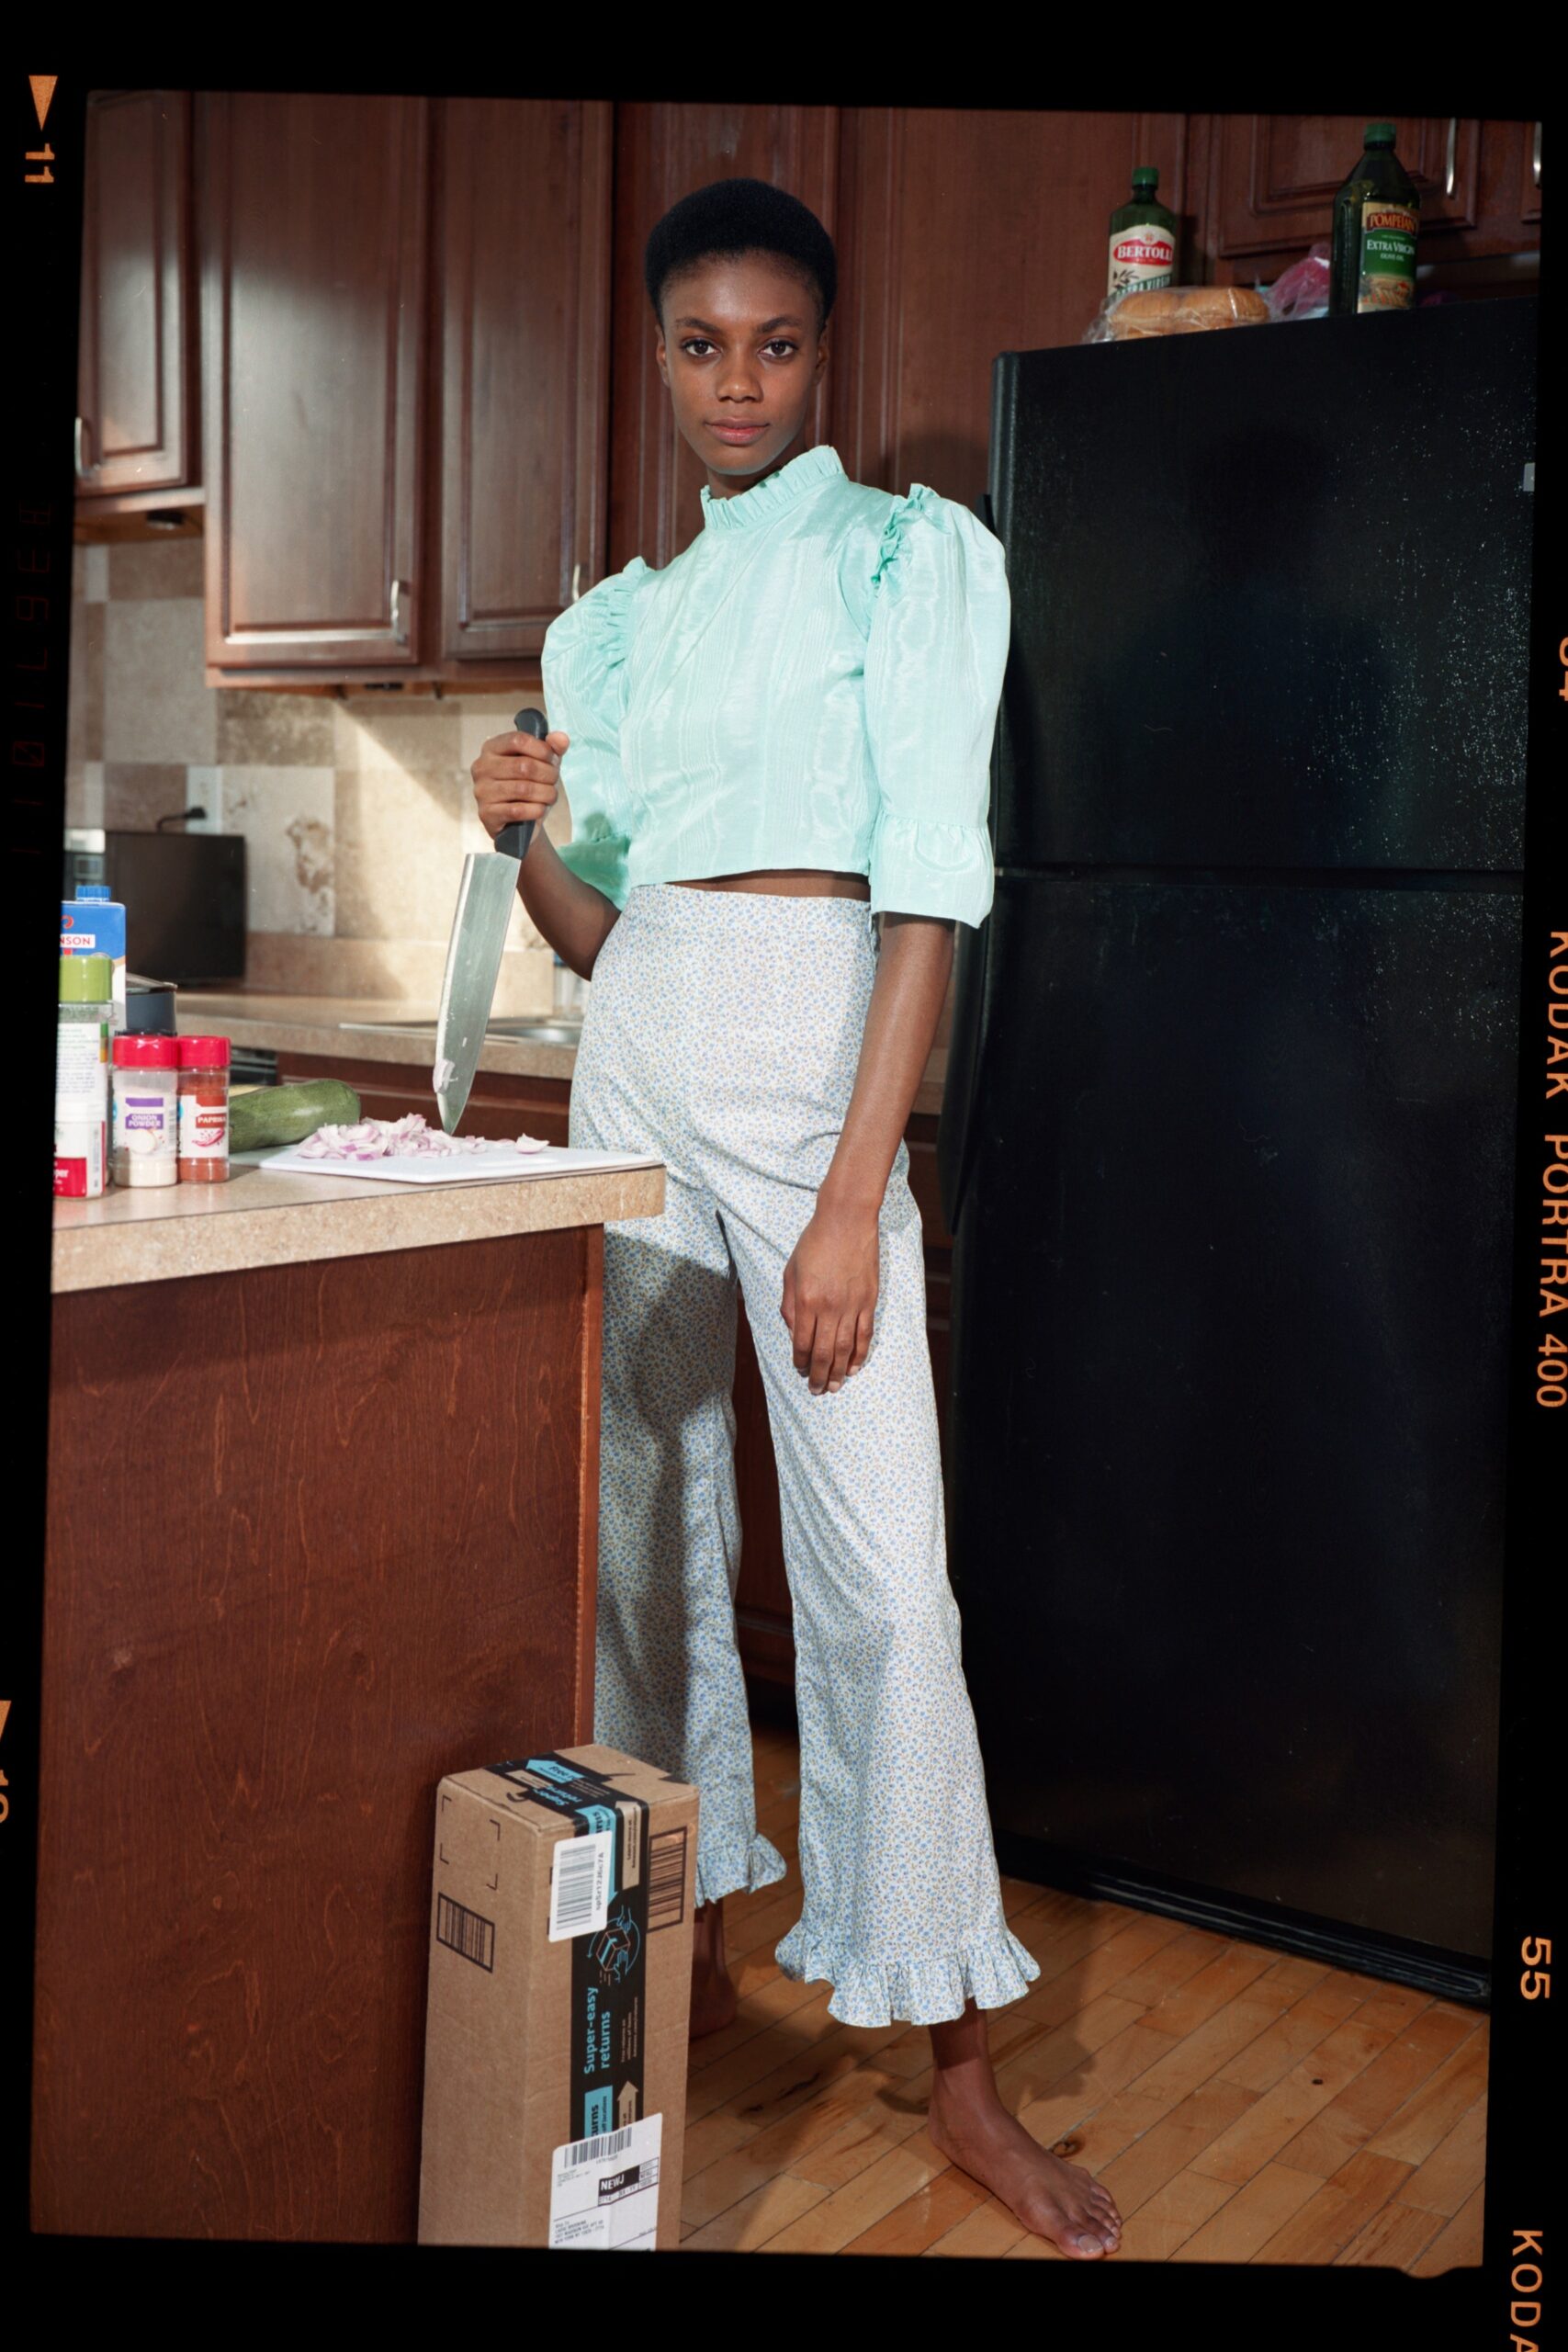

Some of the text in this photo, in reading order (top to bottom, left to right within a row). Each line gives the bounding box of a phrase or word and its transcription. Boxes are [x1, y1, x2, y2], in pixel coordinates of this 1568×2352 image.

[1367, 239, 1393, 252] EXTRA
[584, 1986, 599, 2074] Super-easy
[599, 2011, 611, 2069] returns
